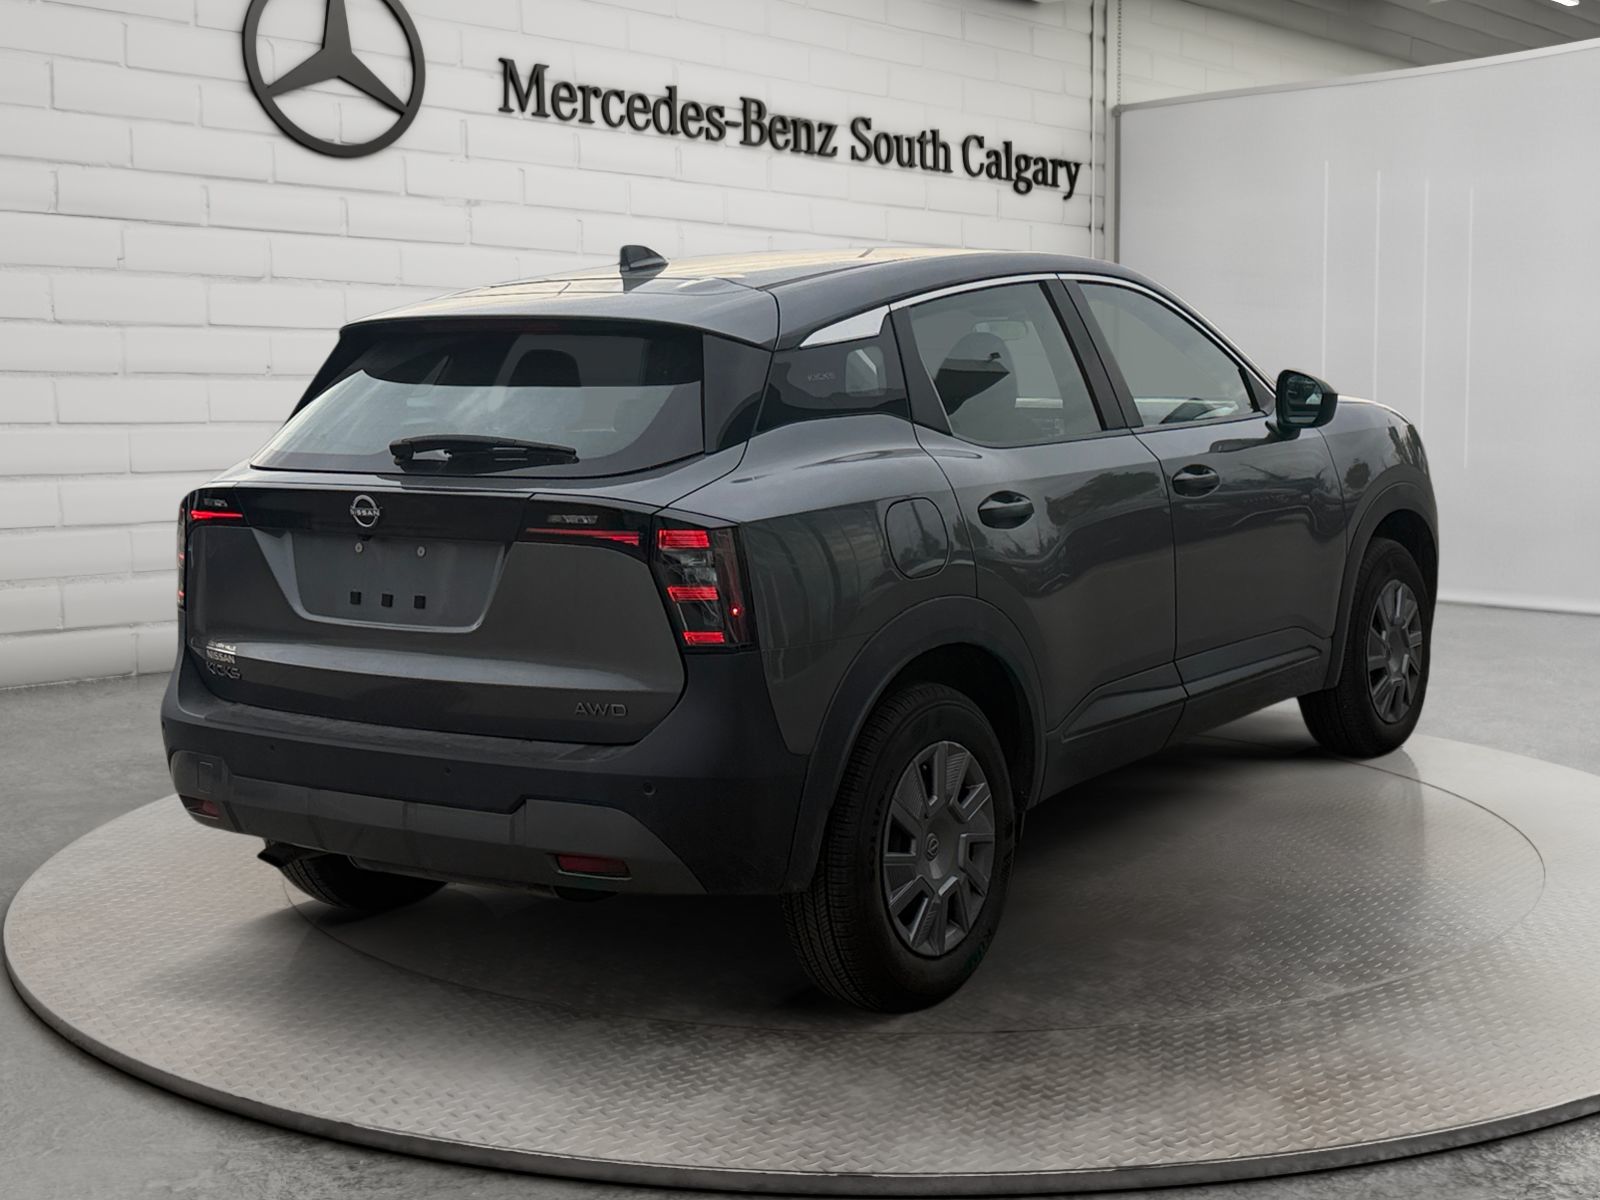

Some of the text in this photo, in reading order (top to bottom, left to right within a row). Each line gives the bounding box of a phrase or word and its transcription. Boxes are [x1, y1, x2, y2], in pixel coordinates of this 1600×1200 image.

[498, 57, 1083, 201] Mercedes-Benz South Calgary
[575, 702, 627, 717] AWD
